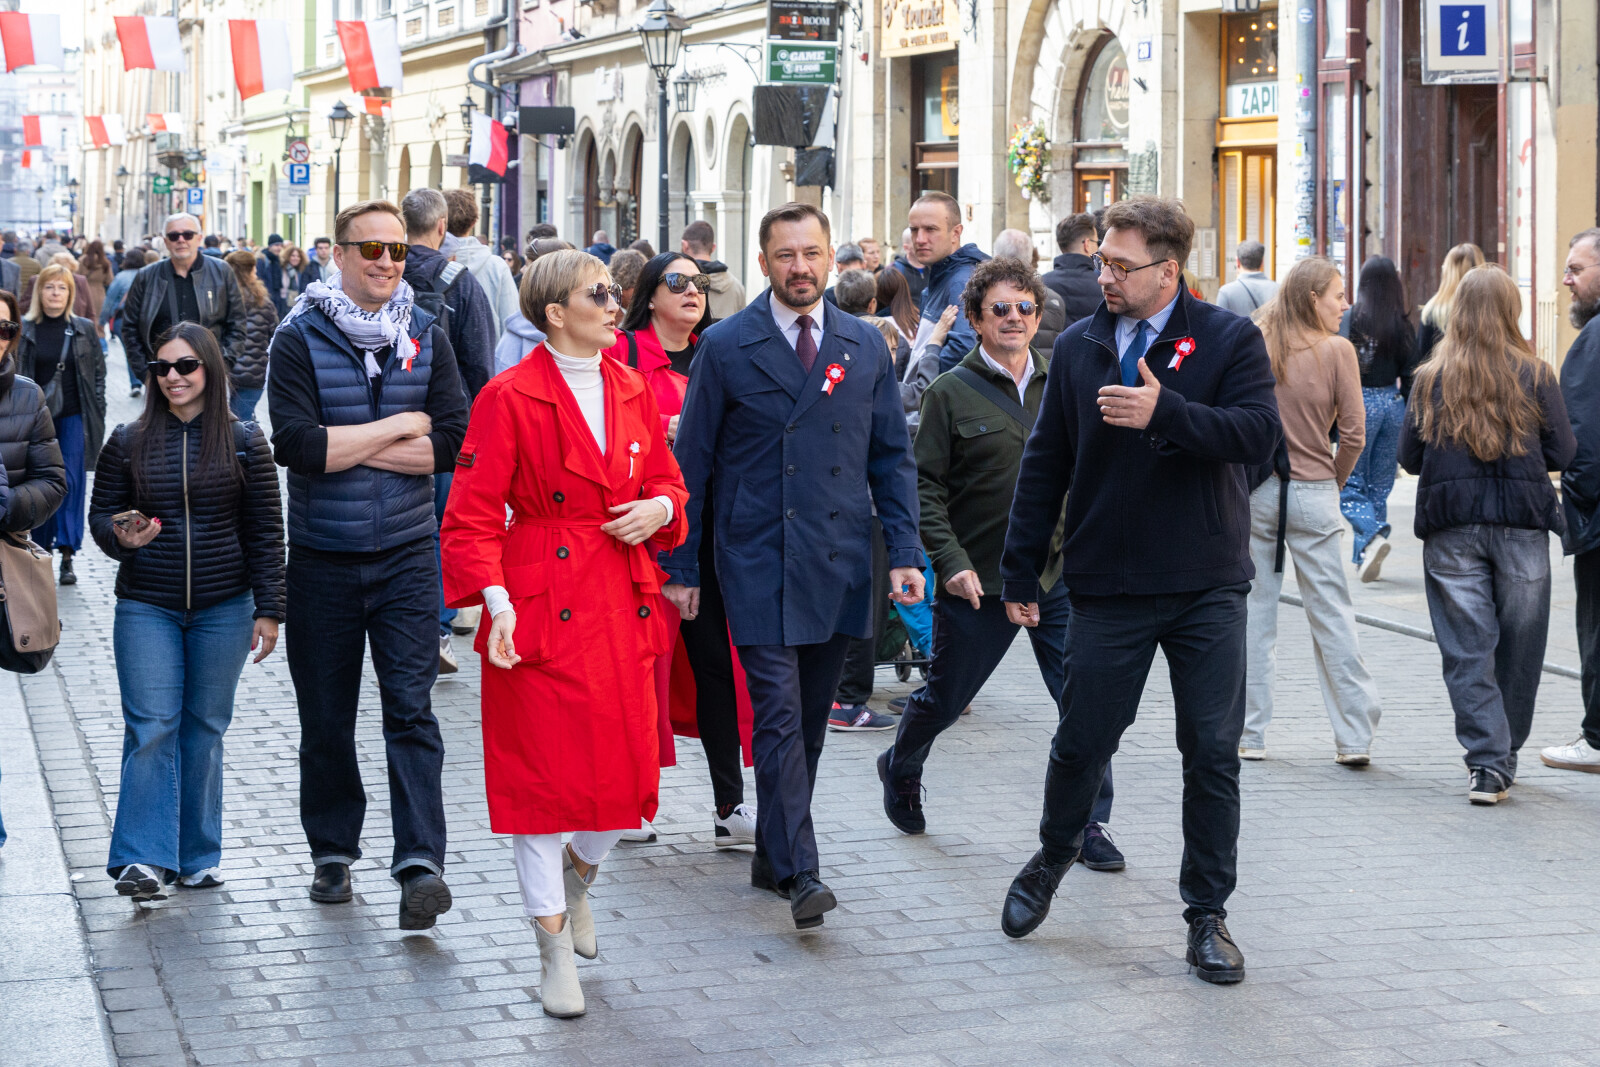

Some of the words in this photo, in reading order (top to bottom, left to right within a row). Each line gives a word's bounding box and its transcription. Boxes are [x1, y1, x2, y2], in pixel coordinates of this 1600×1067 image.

[803, 16, 830, 26] ROOM
[1456, 10, 1471, 51] i
[789, 50, 826, 61] GAME
[794, 64, 820, 73] FLOOR
[1241, 85, 1279, 114] ZAPI
[293, 165, 307, 183] P
